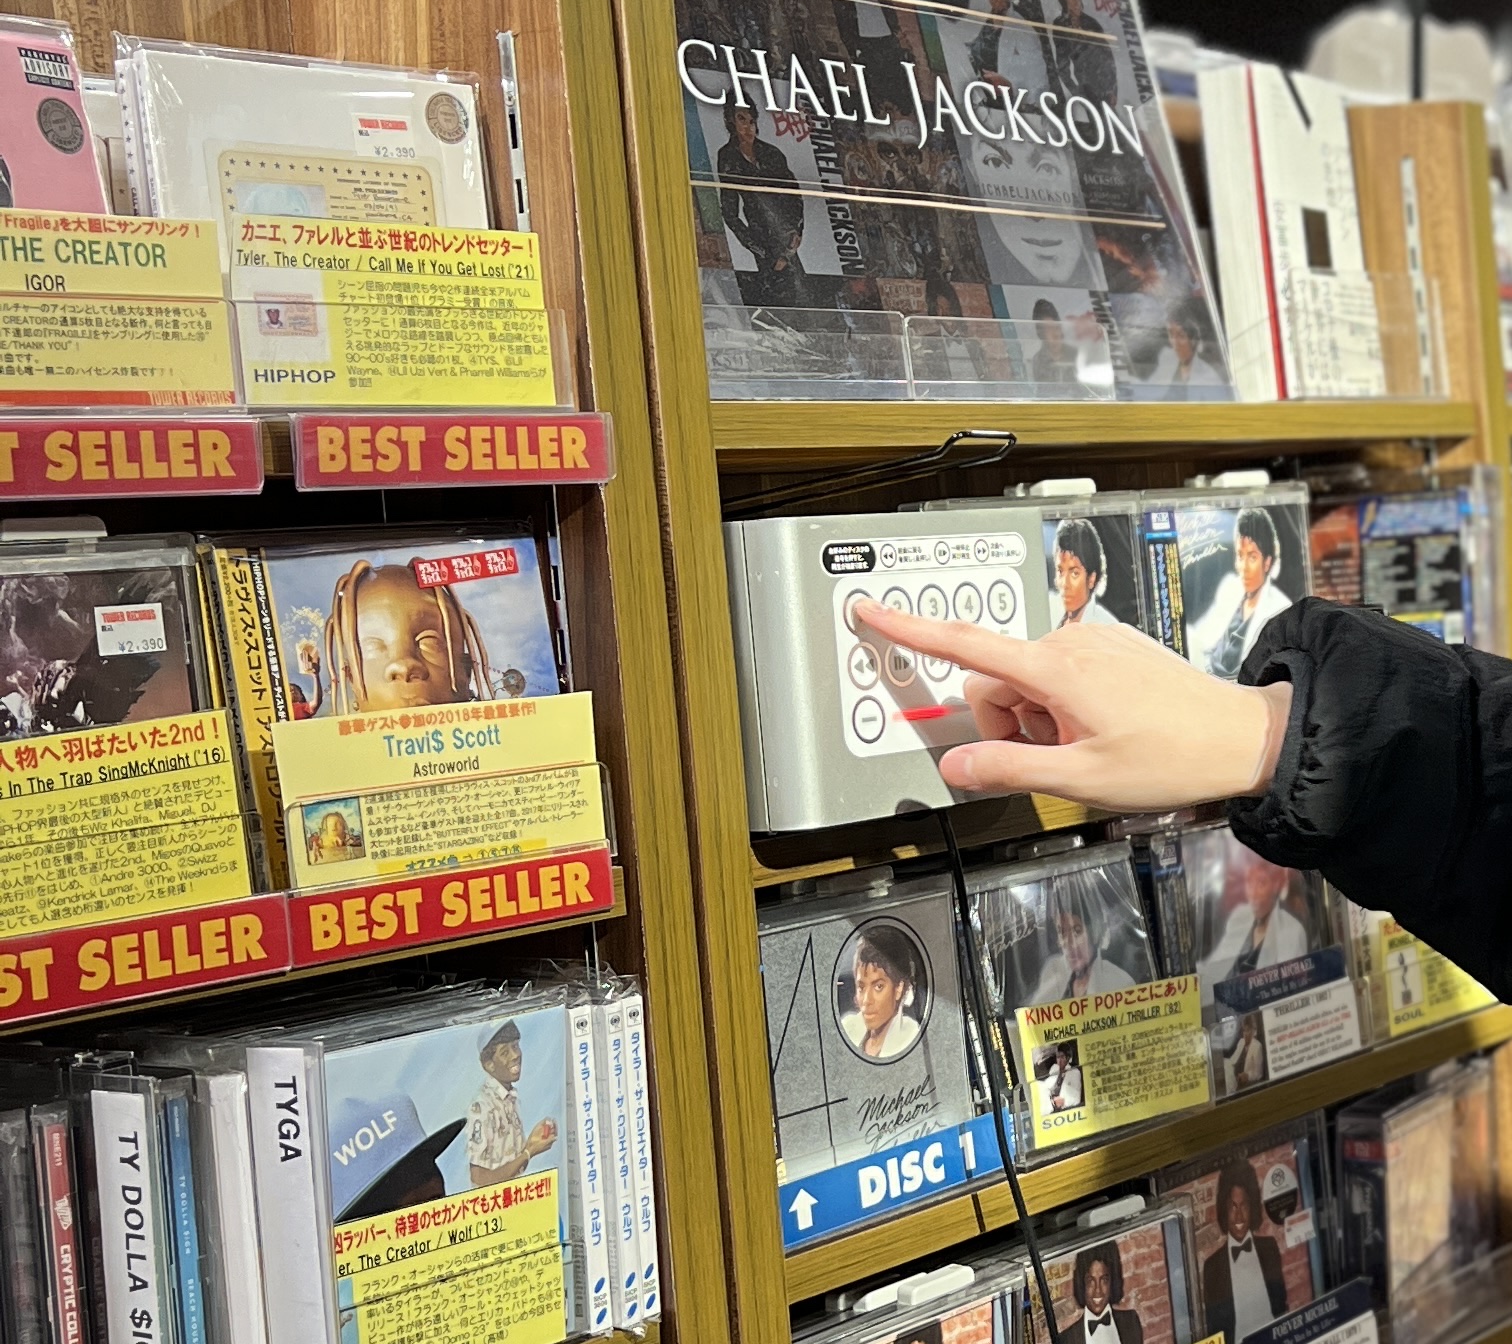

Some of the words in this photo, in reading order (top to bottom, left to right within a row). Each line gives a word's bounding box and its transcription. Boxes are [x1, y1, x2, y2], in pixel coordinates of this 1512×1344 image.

[23, 58, 70, 78] ADVISORY
[900, 61, 1146, 158] JACKSON
[0, 236, 44, 262] THE
[54, 238, 167, 268] CREATOR
[241, 220, 533, 259] カニエ、ファレルと並ぶ世紀のトレンドセッター！
[25, 273, 66, 292] IGOR
[276, 251, 298, 268] The
[303, 253, 350, 270] Creator
[369, 256, 392, 273] Call
[396, 257, 414, 274] Me
[417, 258, 425, 274] If
[429, 259, 453, 276] You
[457, 261, 477, 277] Get
[481, 262, 506, 279] Lost
[254, 369, 336, 384] HIPHOP
[152, 391, 183, 406] TOWER
[187, 391, 232, 405] RECORDS
[45, 430, 236, 482] SELLER
[317, 425, 426, 473] BEST
[444, 425, 590, 471] SELLER
[930, 597, 939, 617] 3
[965, 595, 974, 613] 4
[998, 592, 1007, 611] 5
[383, 729, 444, 757] Travi$
[452, 725, 501, 749] Scott
[8, 780, 21, 798] In
[27, 776, 54, 794] The
[60, 770, 93, 790] Trap
[98, 752, 190, 782] SingMcKnight
[413, 756, 480, 778] Astroworld
[309, 888, 422, 952] BEST
[440, 861, 595, 928] SELLER
[1025, 1004, 1064, 1026] KING
[1069, 998, 1089, 1017] OF
[1094, 976, 1199, 1013] POPここにあり！
[1082, 1014, 1117, 1033] JACKSON
[1127, 1005, 1160, 1024] THRILLER
[1394, 1008, 1425, 1025] SOUL
[273, 1076, 303, 1163] TYGA
[857, 1074, 936, 1131] Michael
[1042, 1112, 1087, 1130] SOUL
[118, 1130, 141, 1172] TY
[332, 1110, 398, 1166] WOLF
[858, 1141, 946, 1209] DISC
[959, 1131, 976, 1171] 1
[589, 1208, 602, 1246] ウルフ
[620, 1204, 633, 1241] ウルフ
[639, 1195, 651, 1233] ウルフ
[121, 1184, 150, 1293] DOLLA
